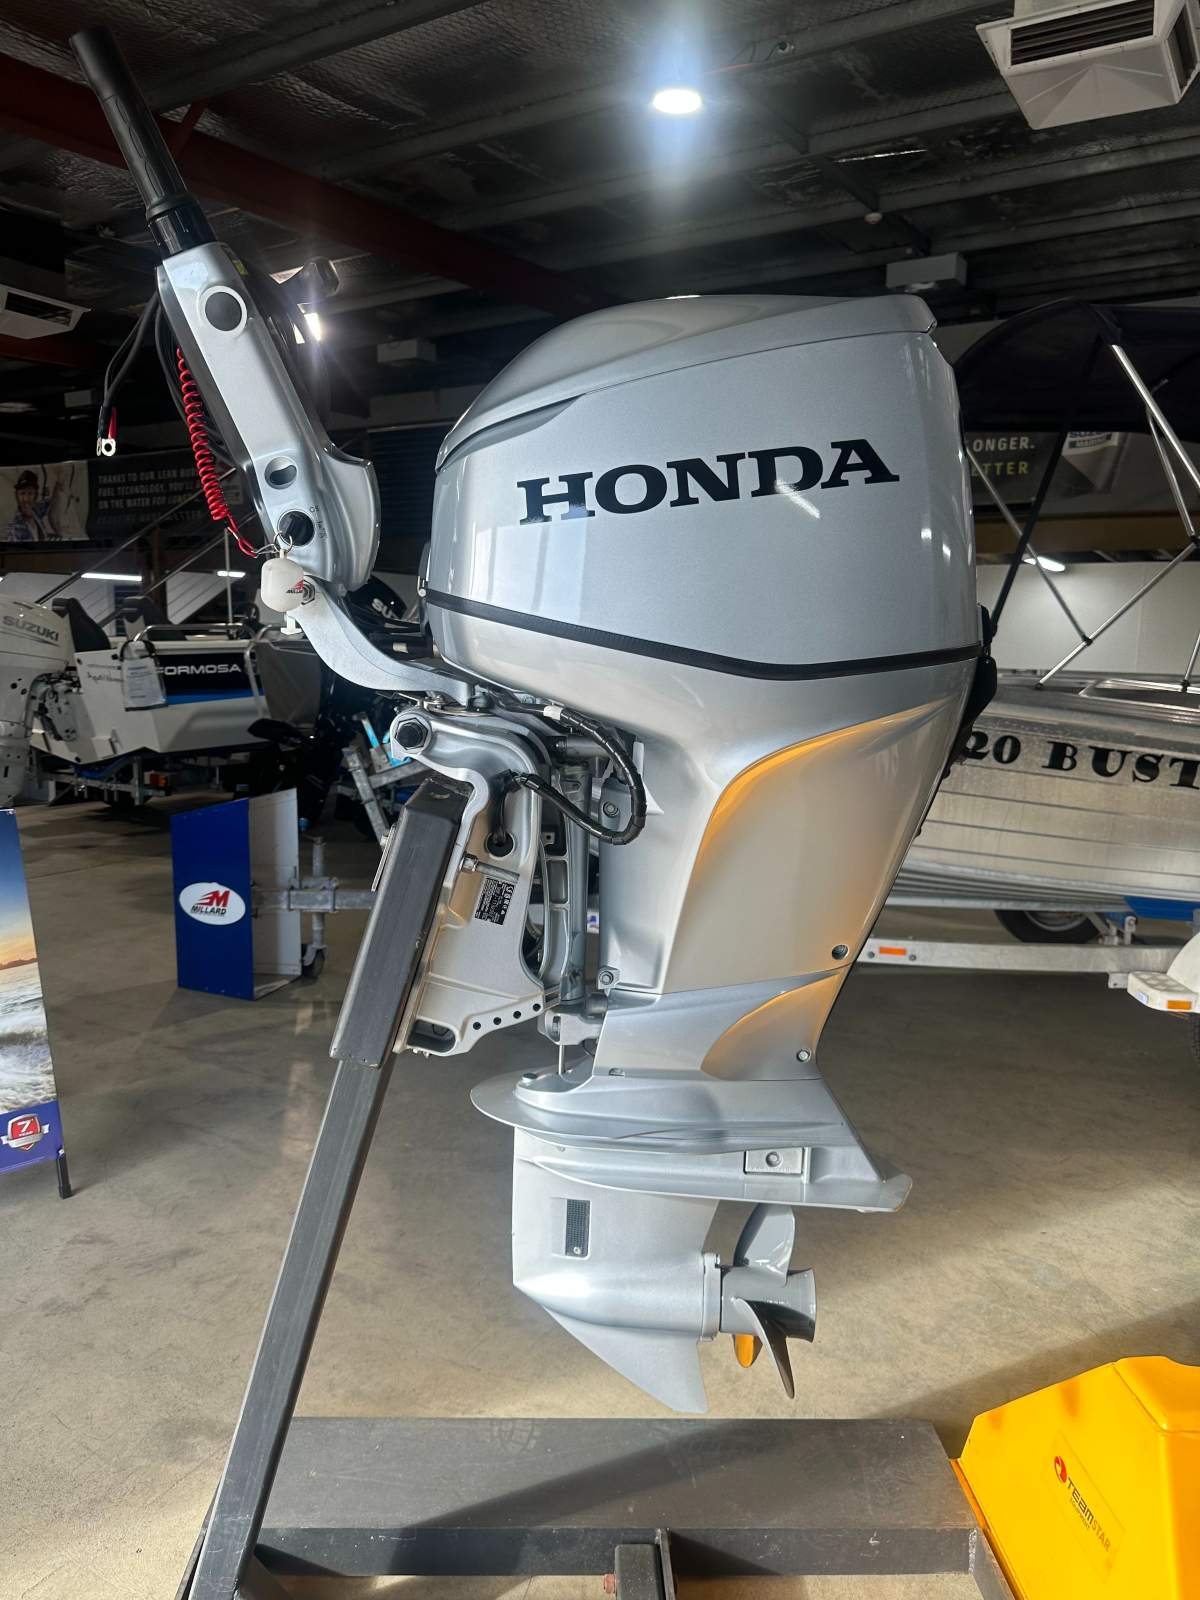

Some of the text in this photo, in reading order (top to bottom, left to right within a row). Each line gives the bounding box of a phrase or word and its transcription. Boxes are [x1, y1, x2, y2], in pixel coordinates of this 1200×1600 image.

[972, 436, 1036, 453] ONGER.
[970, 461, 1030, 478] ETTER
[516, 438, 901, 526] HONDA
[2, 615, 60, 641] SUZUKI
[190, 905, 227, 915] MILLARD
